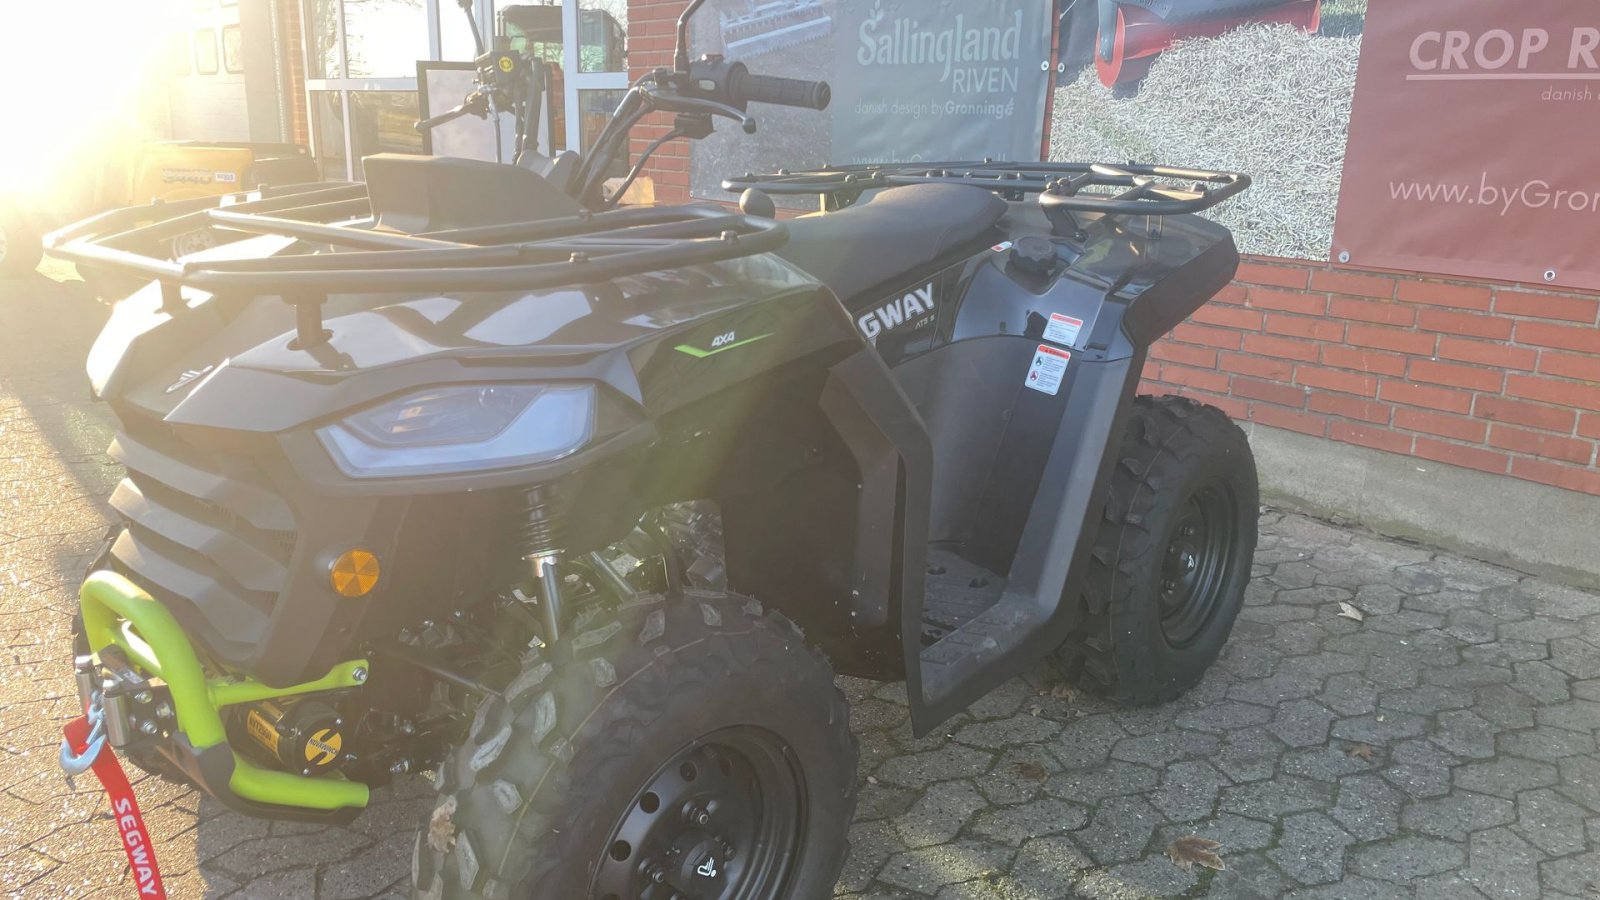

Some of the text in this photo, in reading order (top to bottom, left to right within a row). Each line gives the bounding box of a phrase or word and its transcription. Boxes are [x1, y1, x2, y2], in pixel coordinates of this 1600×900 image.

[857, 9, 1022, 82] Sallingland
[1409, 28, 1549, 71] CROP
[952, 67, 1018, 93] RIVEN
[1541, 84, 1592, 101] danish
[854, 99, 888, 114] danish
[891, 99, 928, 119] design
[115, 798, 157, 895] SEGWAY
